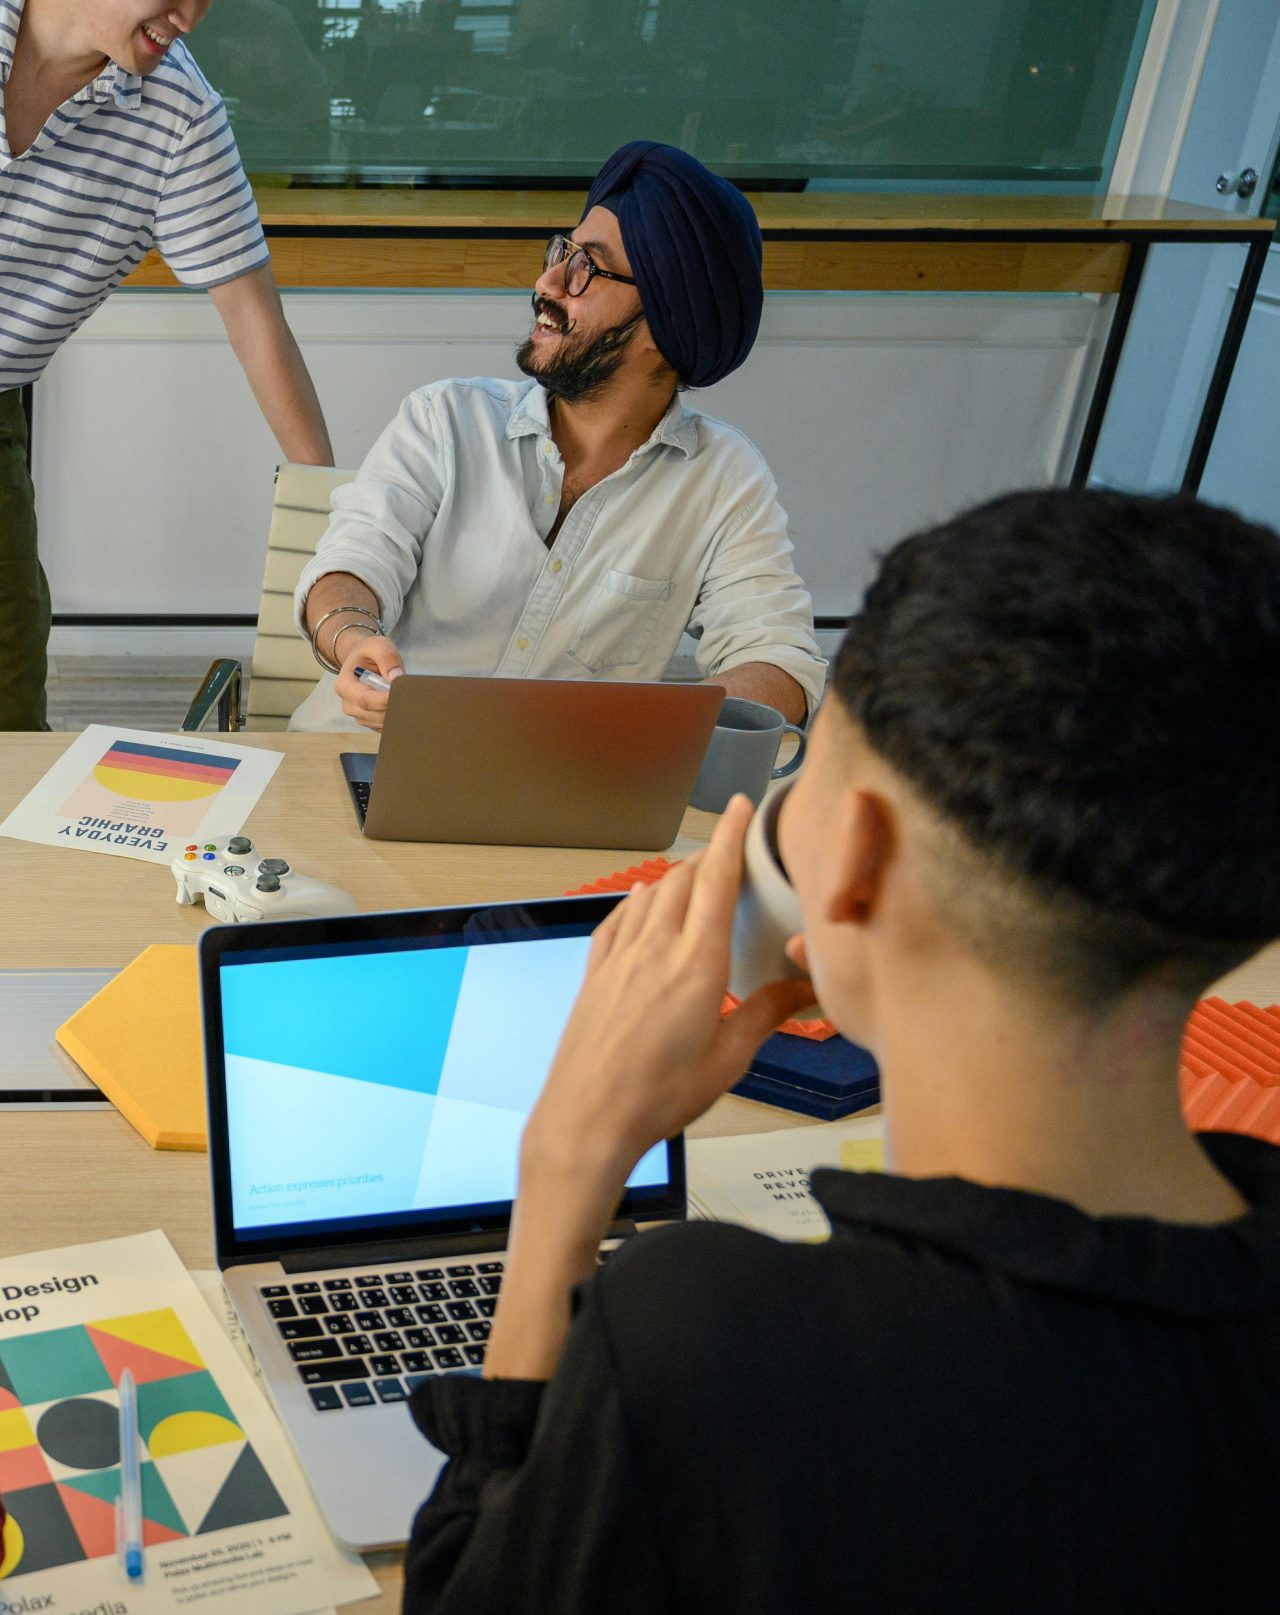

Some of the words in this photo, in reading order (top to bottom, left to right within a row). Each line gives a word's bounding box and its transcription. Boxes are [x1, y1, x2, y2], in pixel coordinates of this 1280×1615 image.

[58, 825, 169, 852] EVERYDAY
[78, 816, 165, 839] GRAPHIC
[249, 1183, 285, 1196] Action
[285, 1177, 336, 1193] expresses
[1, 1273, 99, 1301] Design
